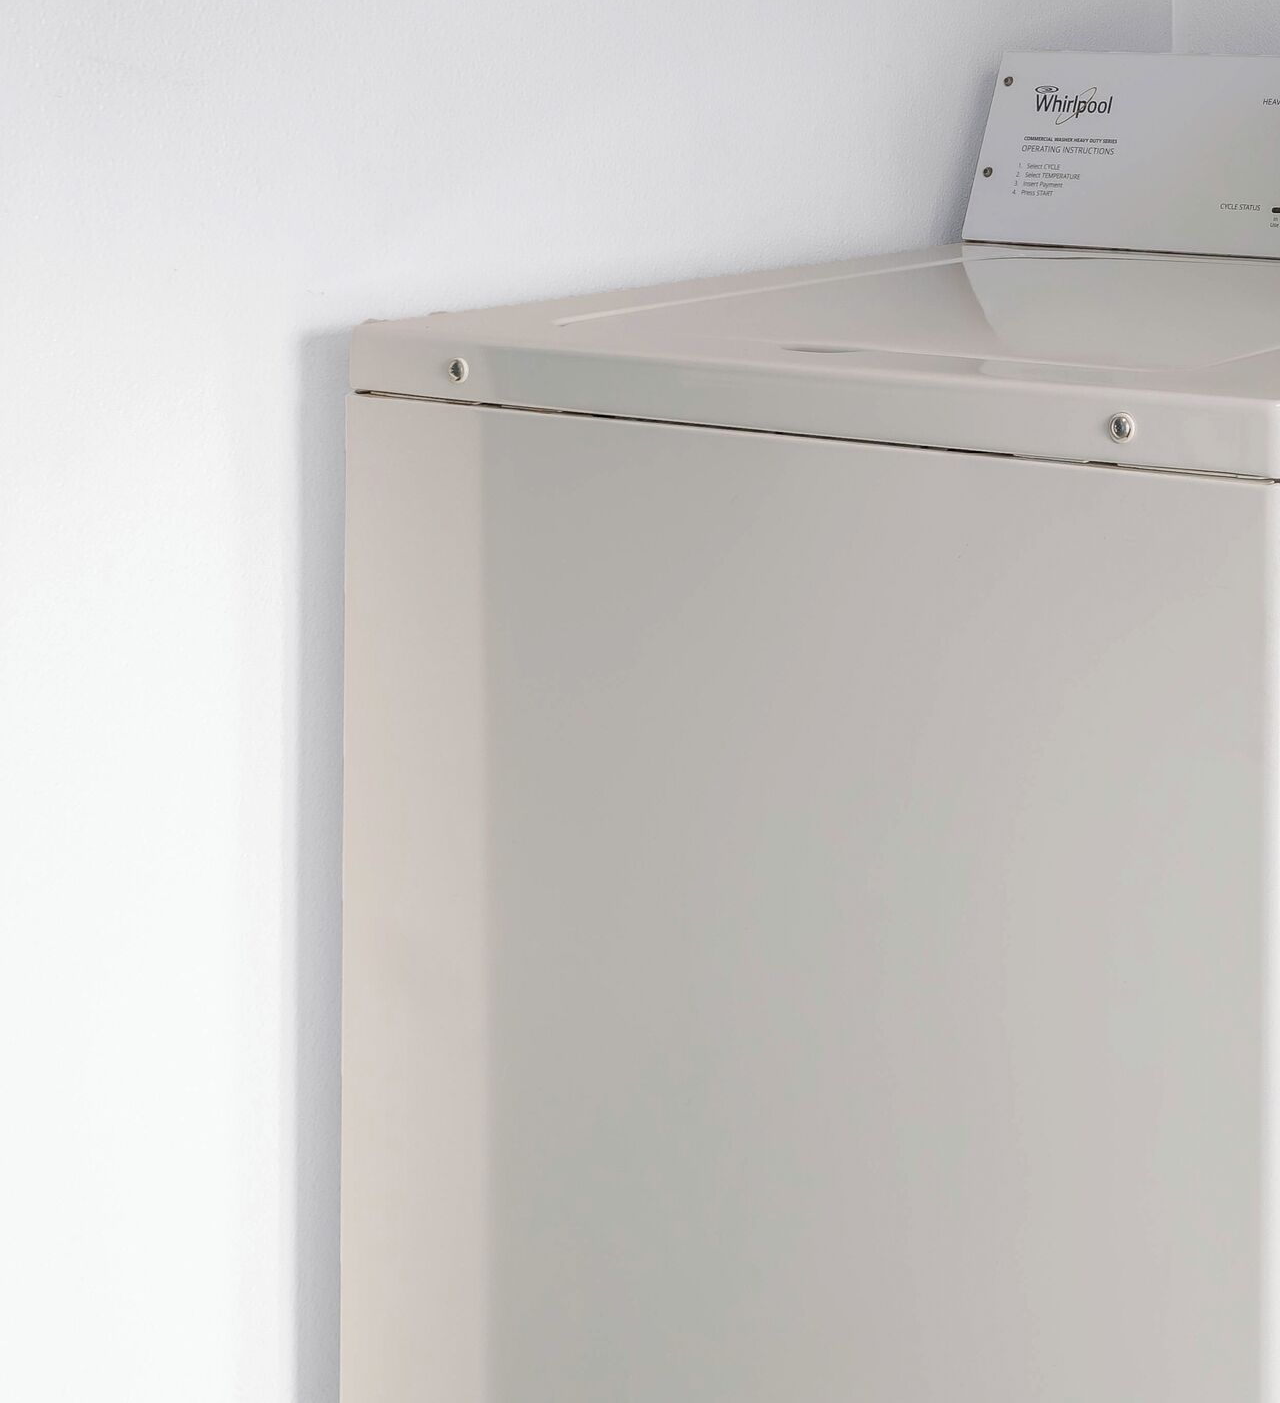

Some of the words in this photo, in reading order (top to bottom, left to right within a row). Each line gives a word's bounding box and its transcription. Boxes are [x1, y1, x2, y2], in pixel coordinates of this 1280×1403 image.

[1036, 94, 1113, 118] Whirlpool
[1021, 144, 1061, 153] OPERATING
[1062, 146, 1115, 155] INSTRUCTIONS
[1239, 203, 1261, 211] STATUS
